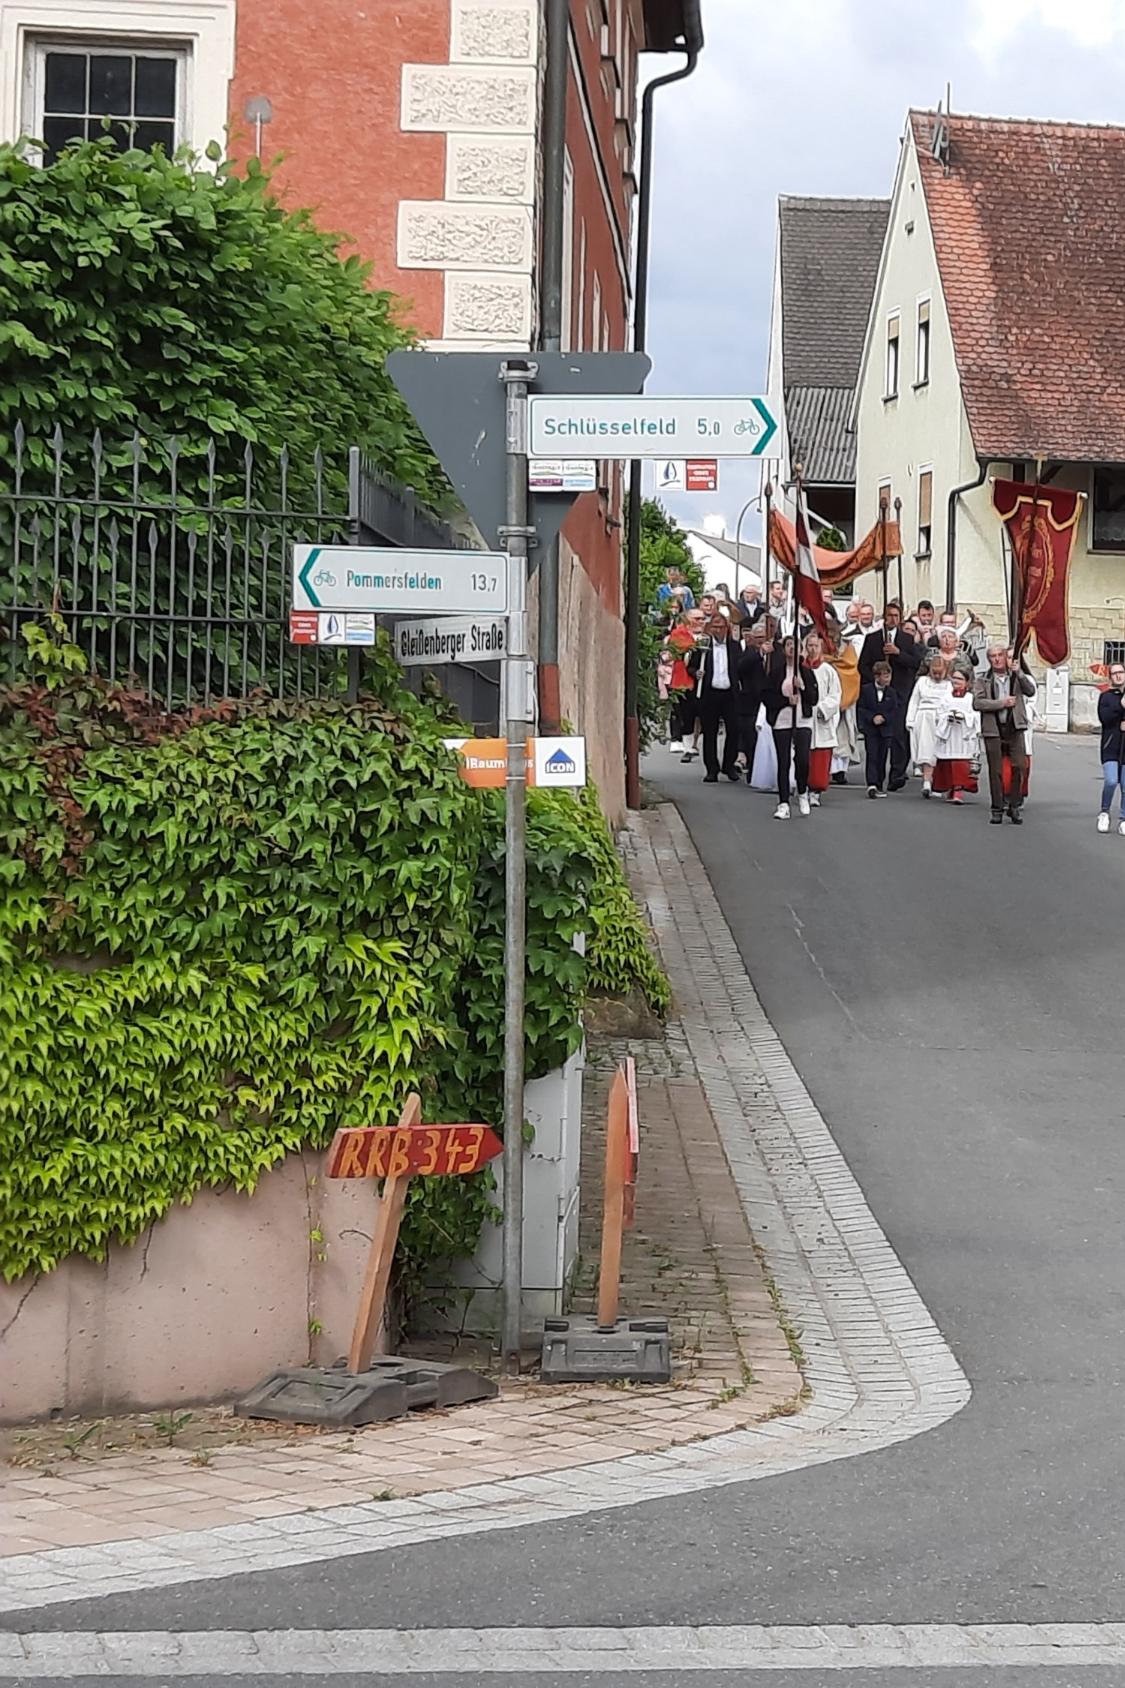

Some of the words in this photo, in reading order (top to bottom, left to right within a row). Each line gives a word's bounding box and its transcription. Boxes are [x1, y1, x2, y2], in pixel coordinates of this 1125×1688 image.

[544, 418, 676, 435] Schlüsselfeld
[346, 569, 442, 590] Pommersfelden
[401, 626, 466, 661] Gleißenberger
[471, 623, 503, 652] Straße
[546, 762, 575, 773] ICON
[418, 1127, 484, 1175] 343
